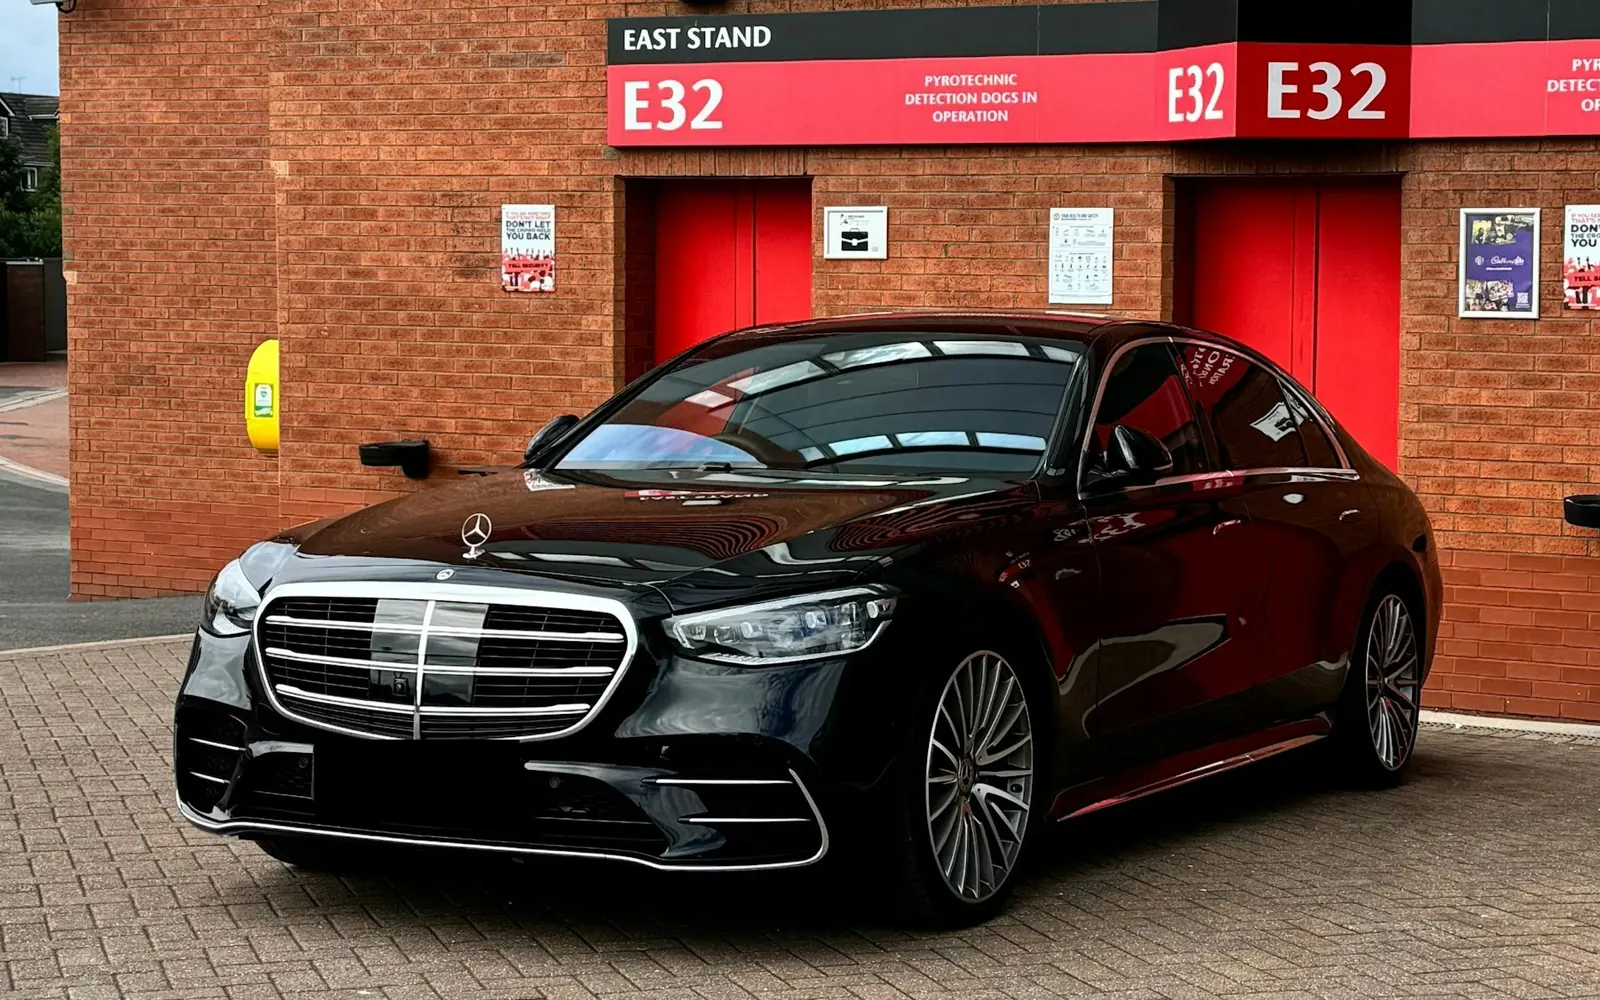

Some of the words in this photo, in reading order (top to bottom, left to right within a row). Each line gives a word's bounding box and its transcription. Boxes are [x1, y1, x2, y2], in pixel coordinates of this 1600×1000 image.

[624, 28, 681, 51] EAST
[687, 26, 772, 49] STAND
[924, 73, 1018, 87] PYROTECHNIC
[905, 92, 977, 105] DETECTION
[981, 91, 1019, 104] DOGS
[1022, 91, 1038, 104] IN
[1168, 62, 1225, 123] E32
[1267, 61, 1387, 120] E32
[624, 78, 723, 131] E32
[932, 110, 1009, 123] OPERATION
[1571, 239, 1597, 247] YOU
